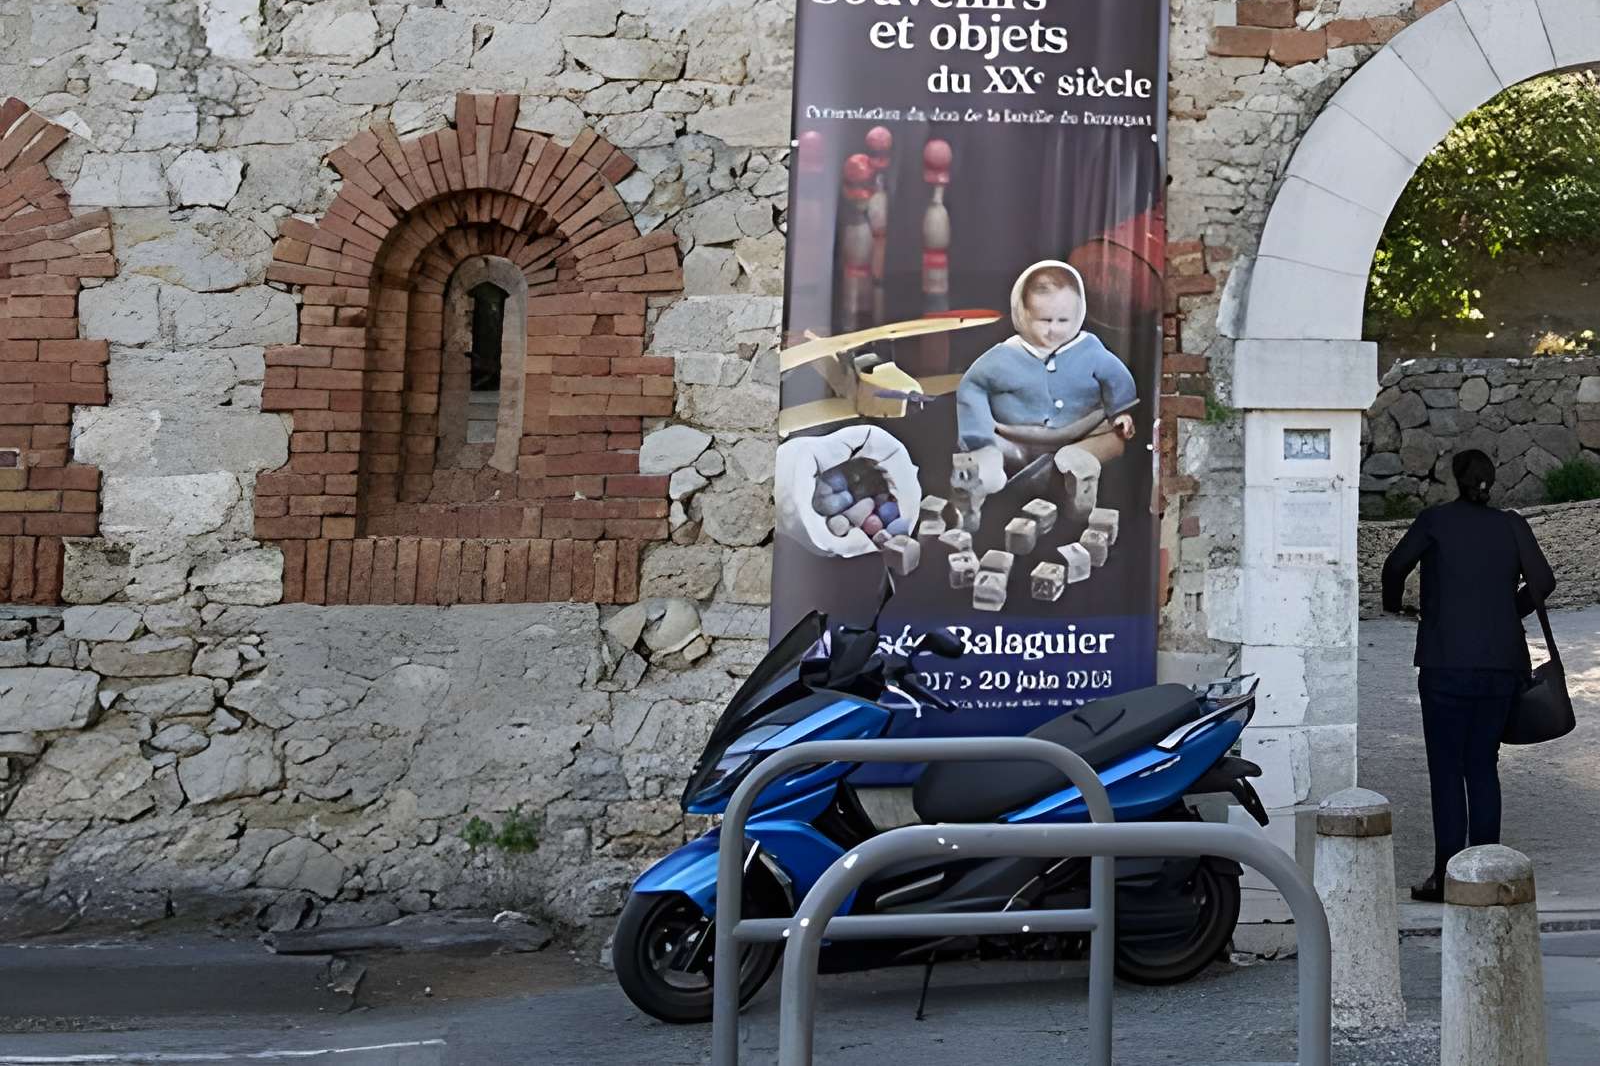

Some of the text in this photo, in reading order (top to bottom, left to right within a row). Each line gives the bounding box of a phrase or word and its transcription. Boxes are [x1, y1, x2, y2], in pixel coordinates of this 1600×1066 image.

[869, 13, 1069, 60] et objets
[927, 65, 972, 94] du
[1057, 66, 1152, 99] siècle
[946, 624, 1116, 661] Balaguier
[978, 670, 1012, 690] 20
